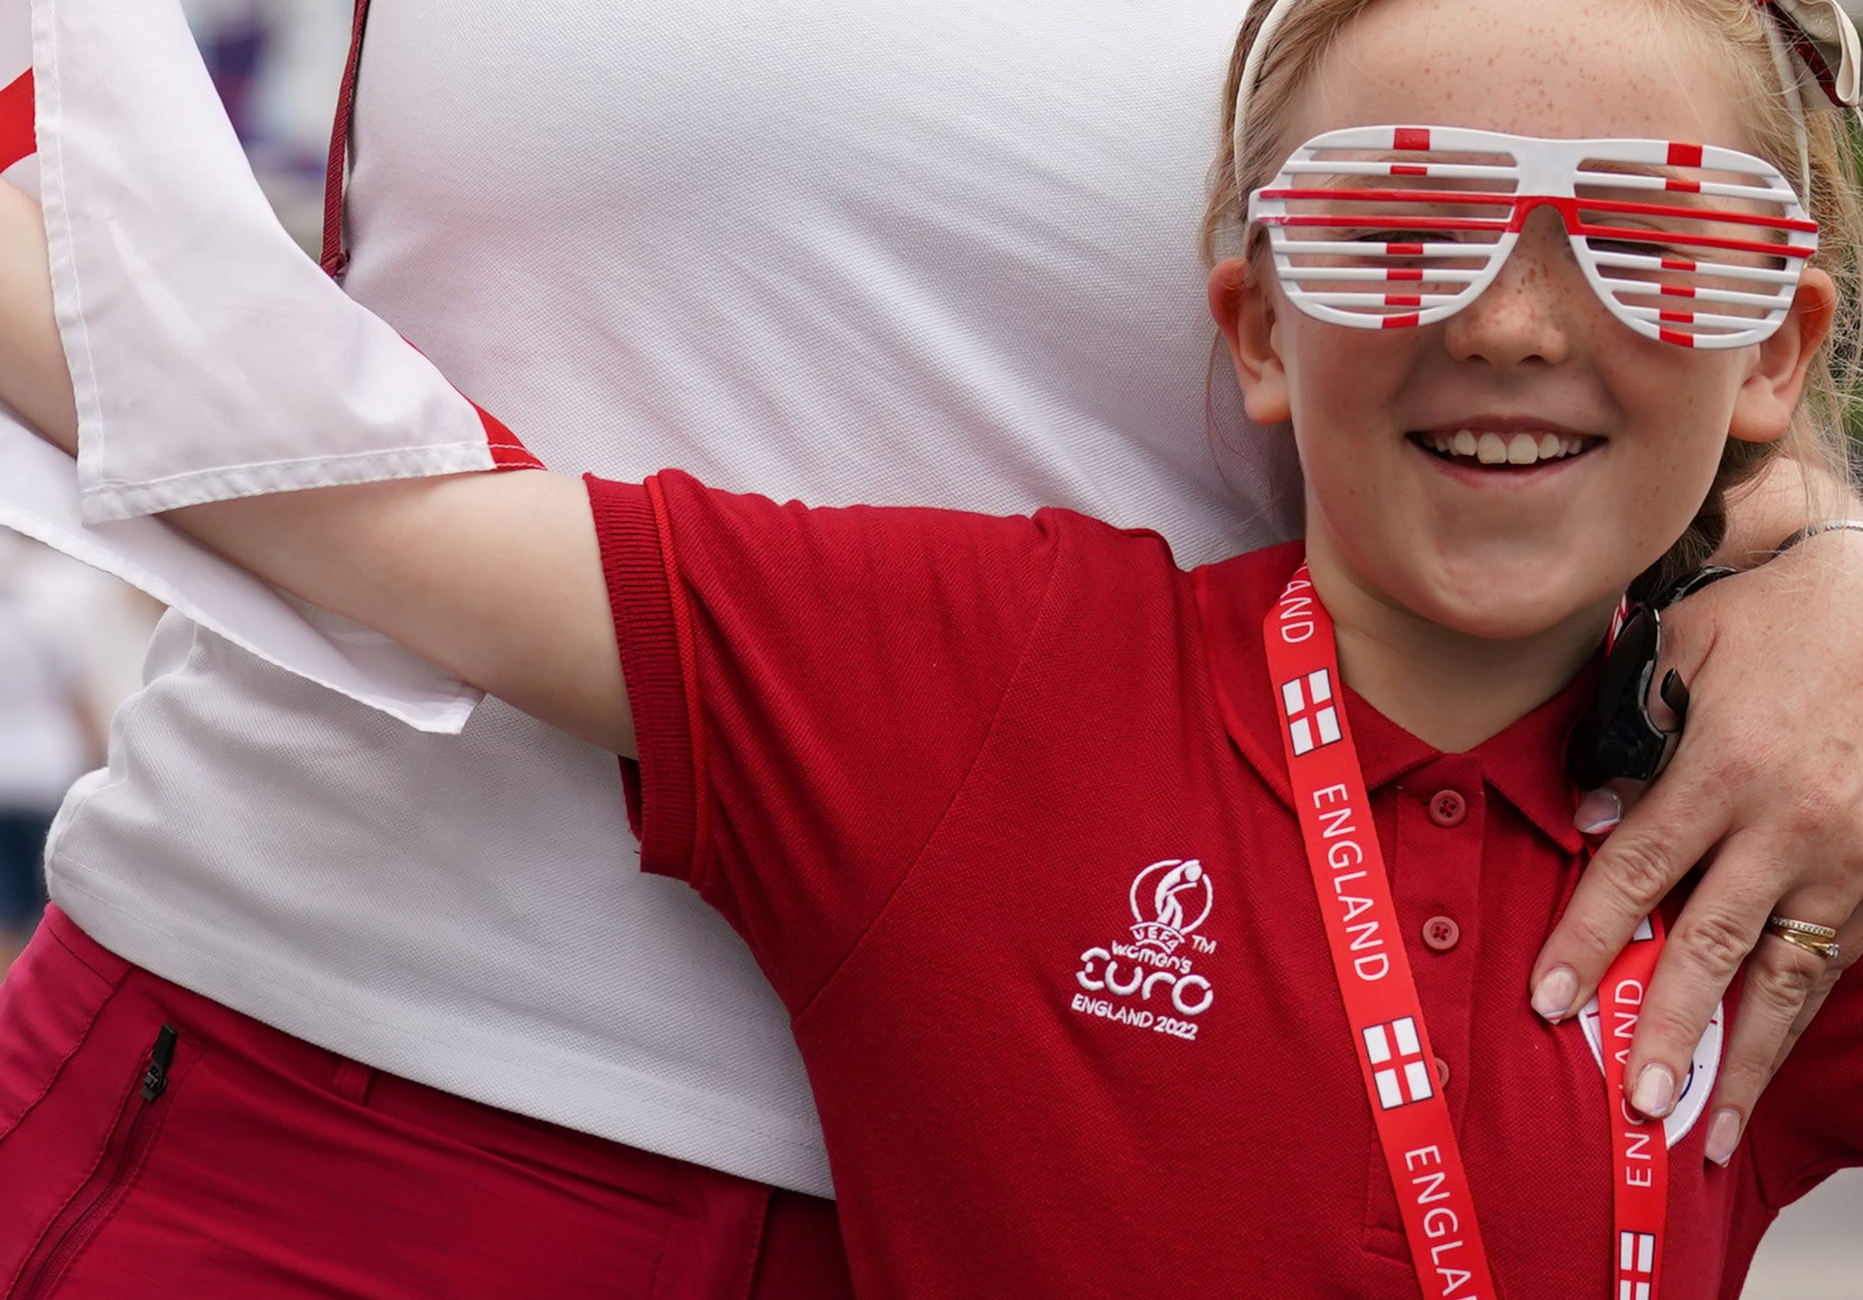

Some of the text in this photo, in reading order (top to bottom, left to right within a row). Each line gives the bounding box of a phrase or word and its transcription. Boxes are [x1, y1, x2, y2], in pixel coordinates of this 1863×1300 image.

[1312, 783, 1390, 981] ENGLAND
[1111, 940, 1192, 975] women's
[1133, 926, 1180, 954] UEFA
[1071, 993, 1198, 1041] ENGLAND 2022
[1405, 1145, 1477, 1300] ENGLA
